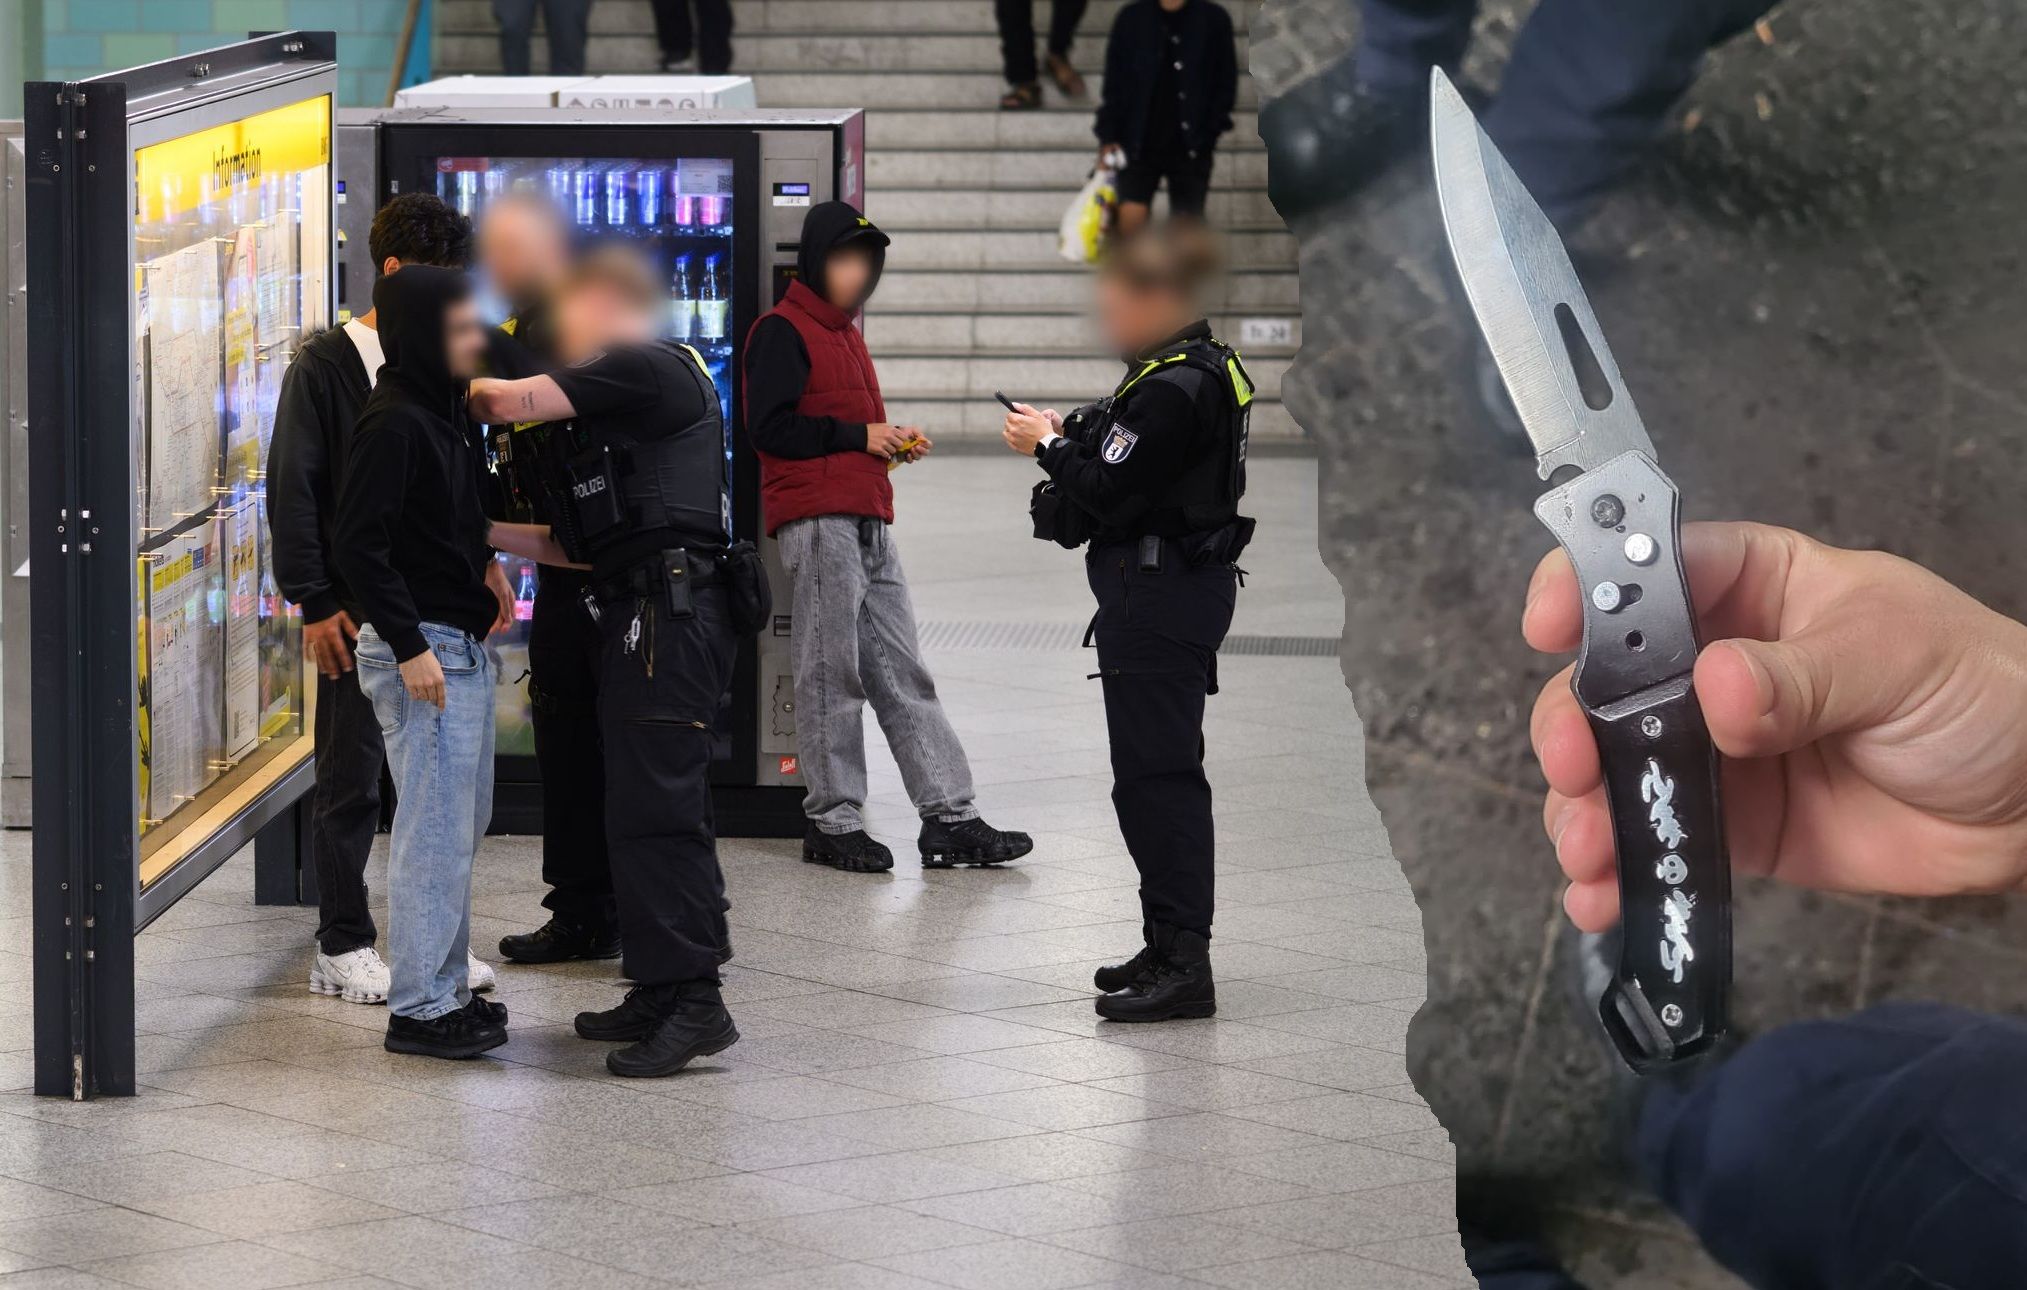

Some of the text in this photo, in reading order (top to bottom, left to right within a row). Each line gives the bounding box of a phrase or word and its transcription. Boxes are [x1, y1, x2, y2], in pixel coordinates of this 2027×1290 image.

[213, 139, 262, 192] Information
[1113, 425, 1137, 443] POLIZEI
[572, 475, 606, 499] POLIZEI
